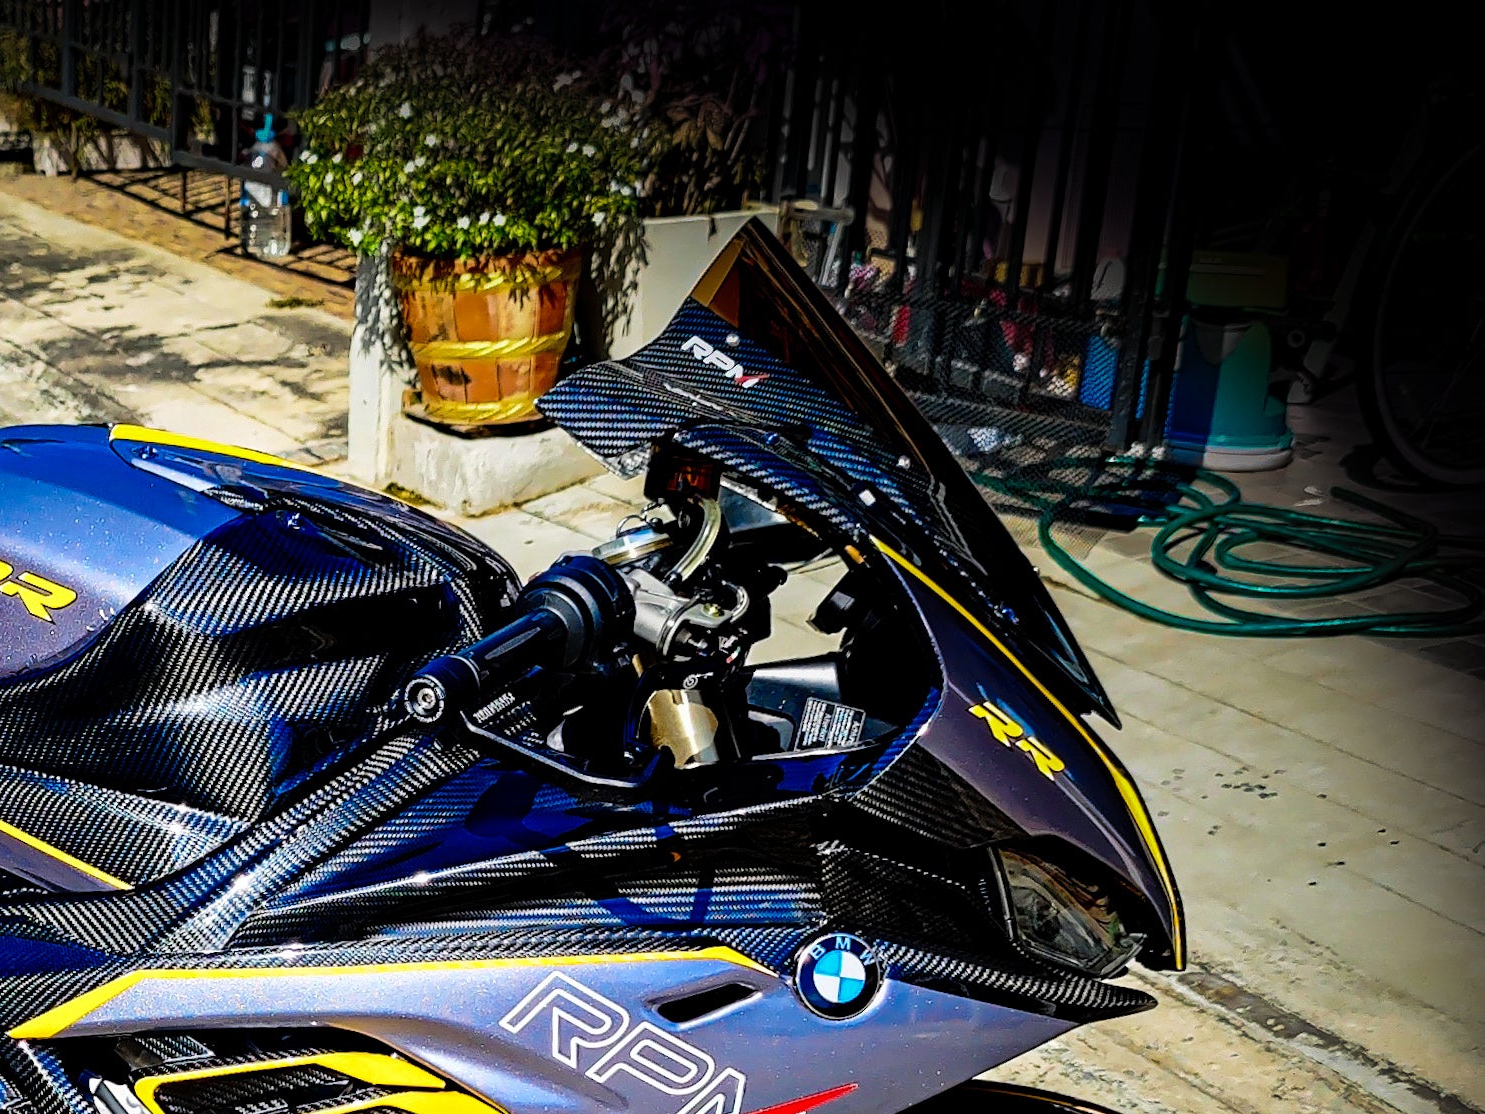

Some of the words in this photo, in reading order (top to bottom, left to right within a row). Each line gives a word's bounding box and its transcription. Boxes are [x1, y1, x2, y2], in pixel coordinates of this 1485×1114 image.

[681, 336, 769, 388] RPM
[966, 701, 1065, 782] RR
[808, 936, 876, 966] BMW
